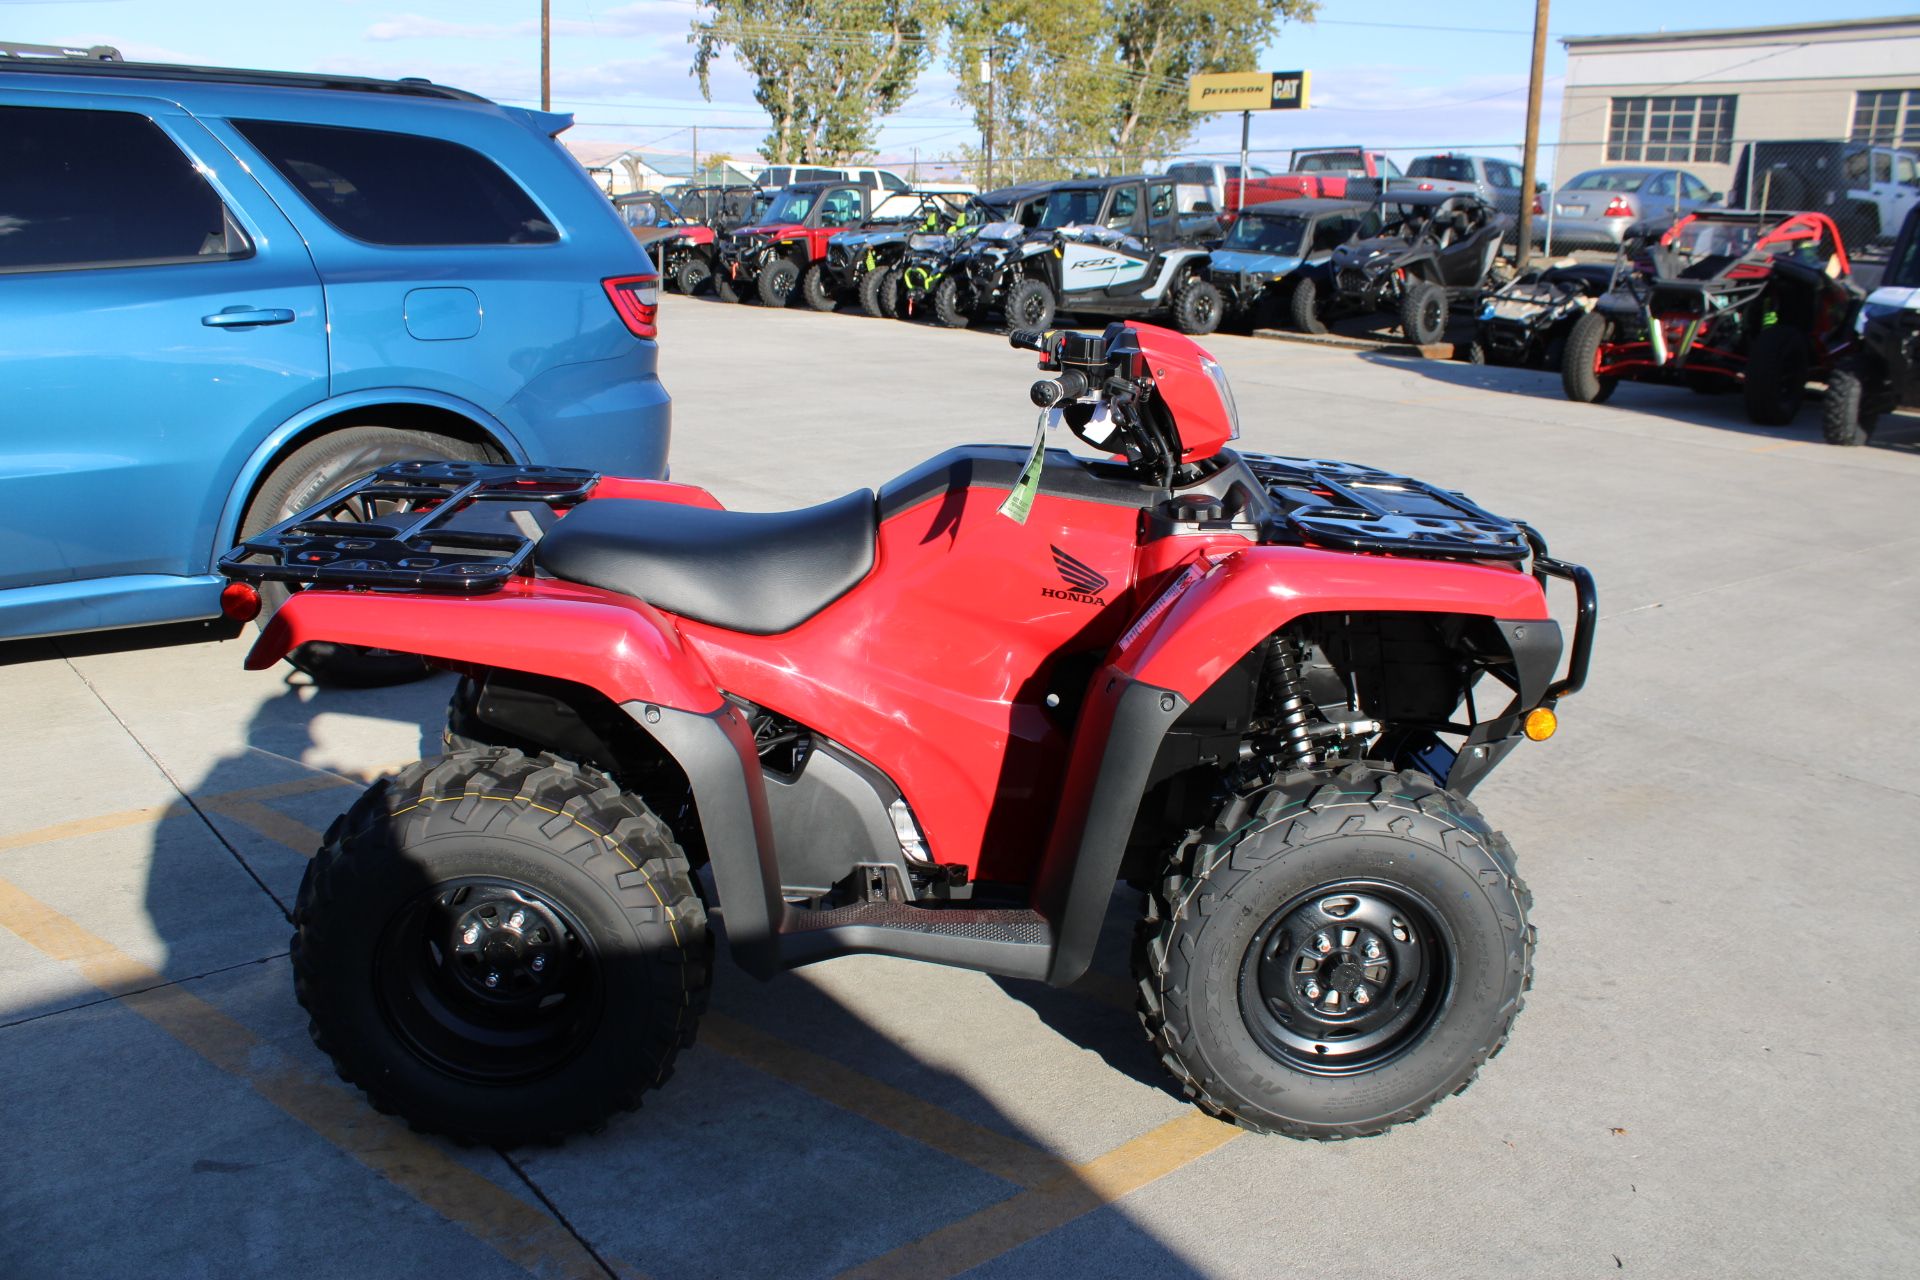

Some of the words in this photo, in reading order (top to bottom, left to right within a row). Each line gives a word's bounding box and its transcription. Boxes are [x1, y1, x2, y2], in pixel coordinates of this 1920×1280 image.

[1202, 86, 1264, 99] PETERSON
[1273, 79, 1299, 99] CAT
[1071, 257, 1116, 269] RZR
[1041, 587, 1107, 607] HONDA
